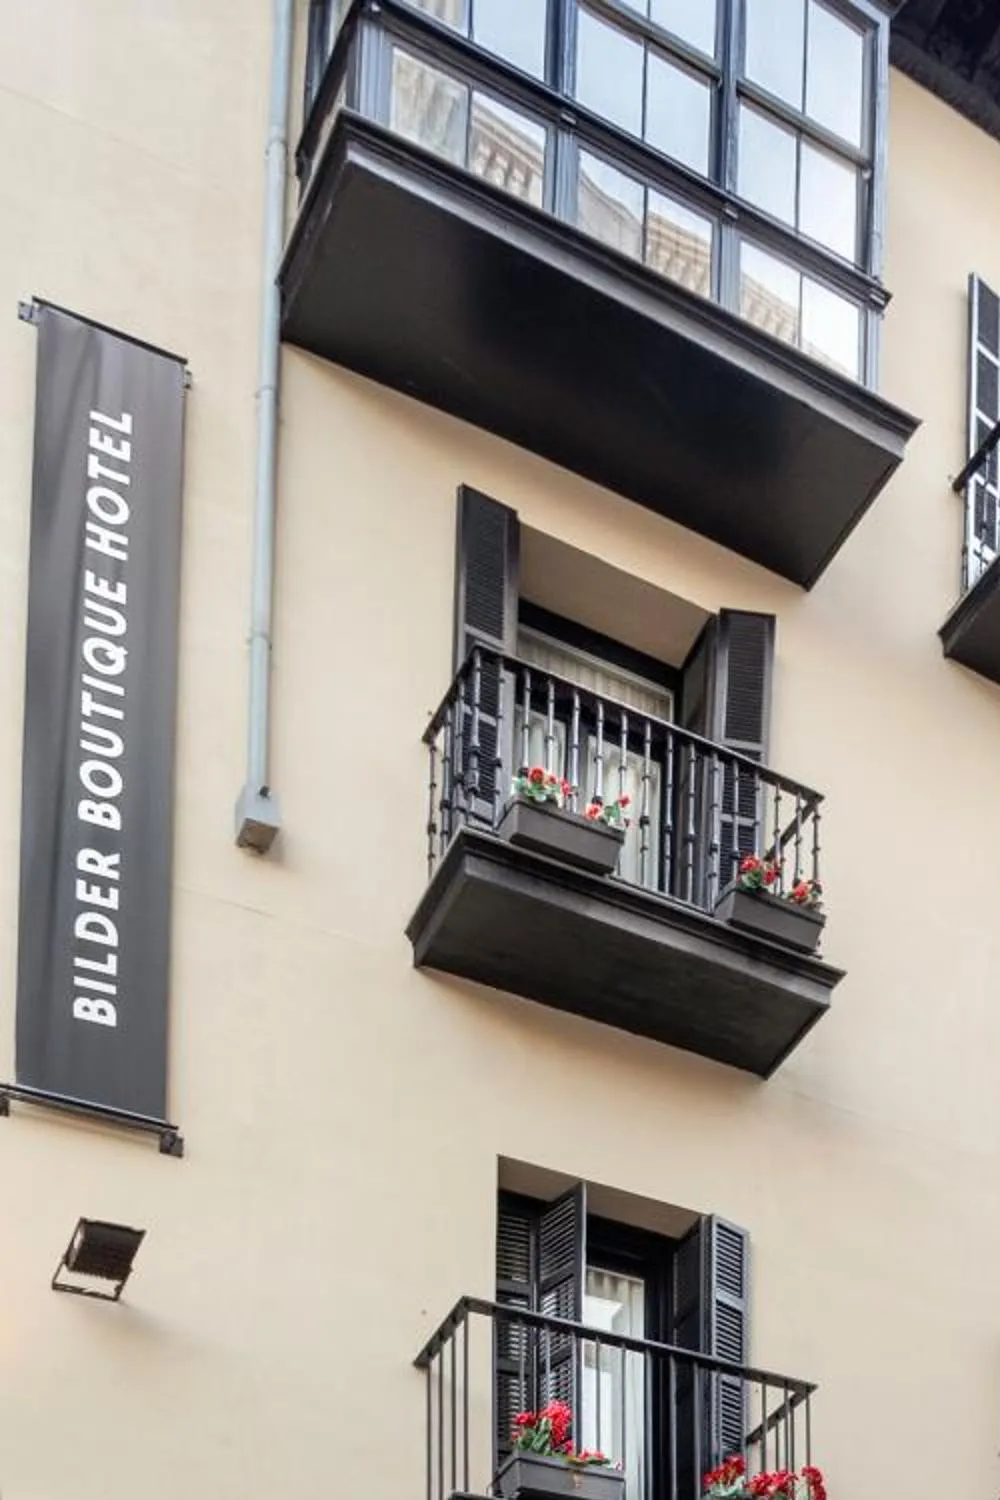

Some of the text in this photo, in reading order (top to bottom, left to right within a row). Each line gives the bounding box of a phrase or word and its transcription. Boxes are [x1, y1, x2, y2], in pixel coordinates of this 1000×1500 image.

[74, 411, 132, 1026] BILDER BOUTIQUE HOTEL
